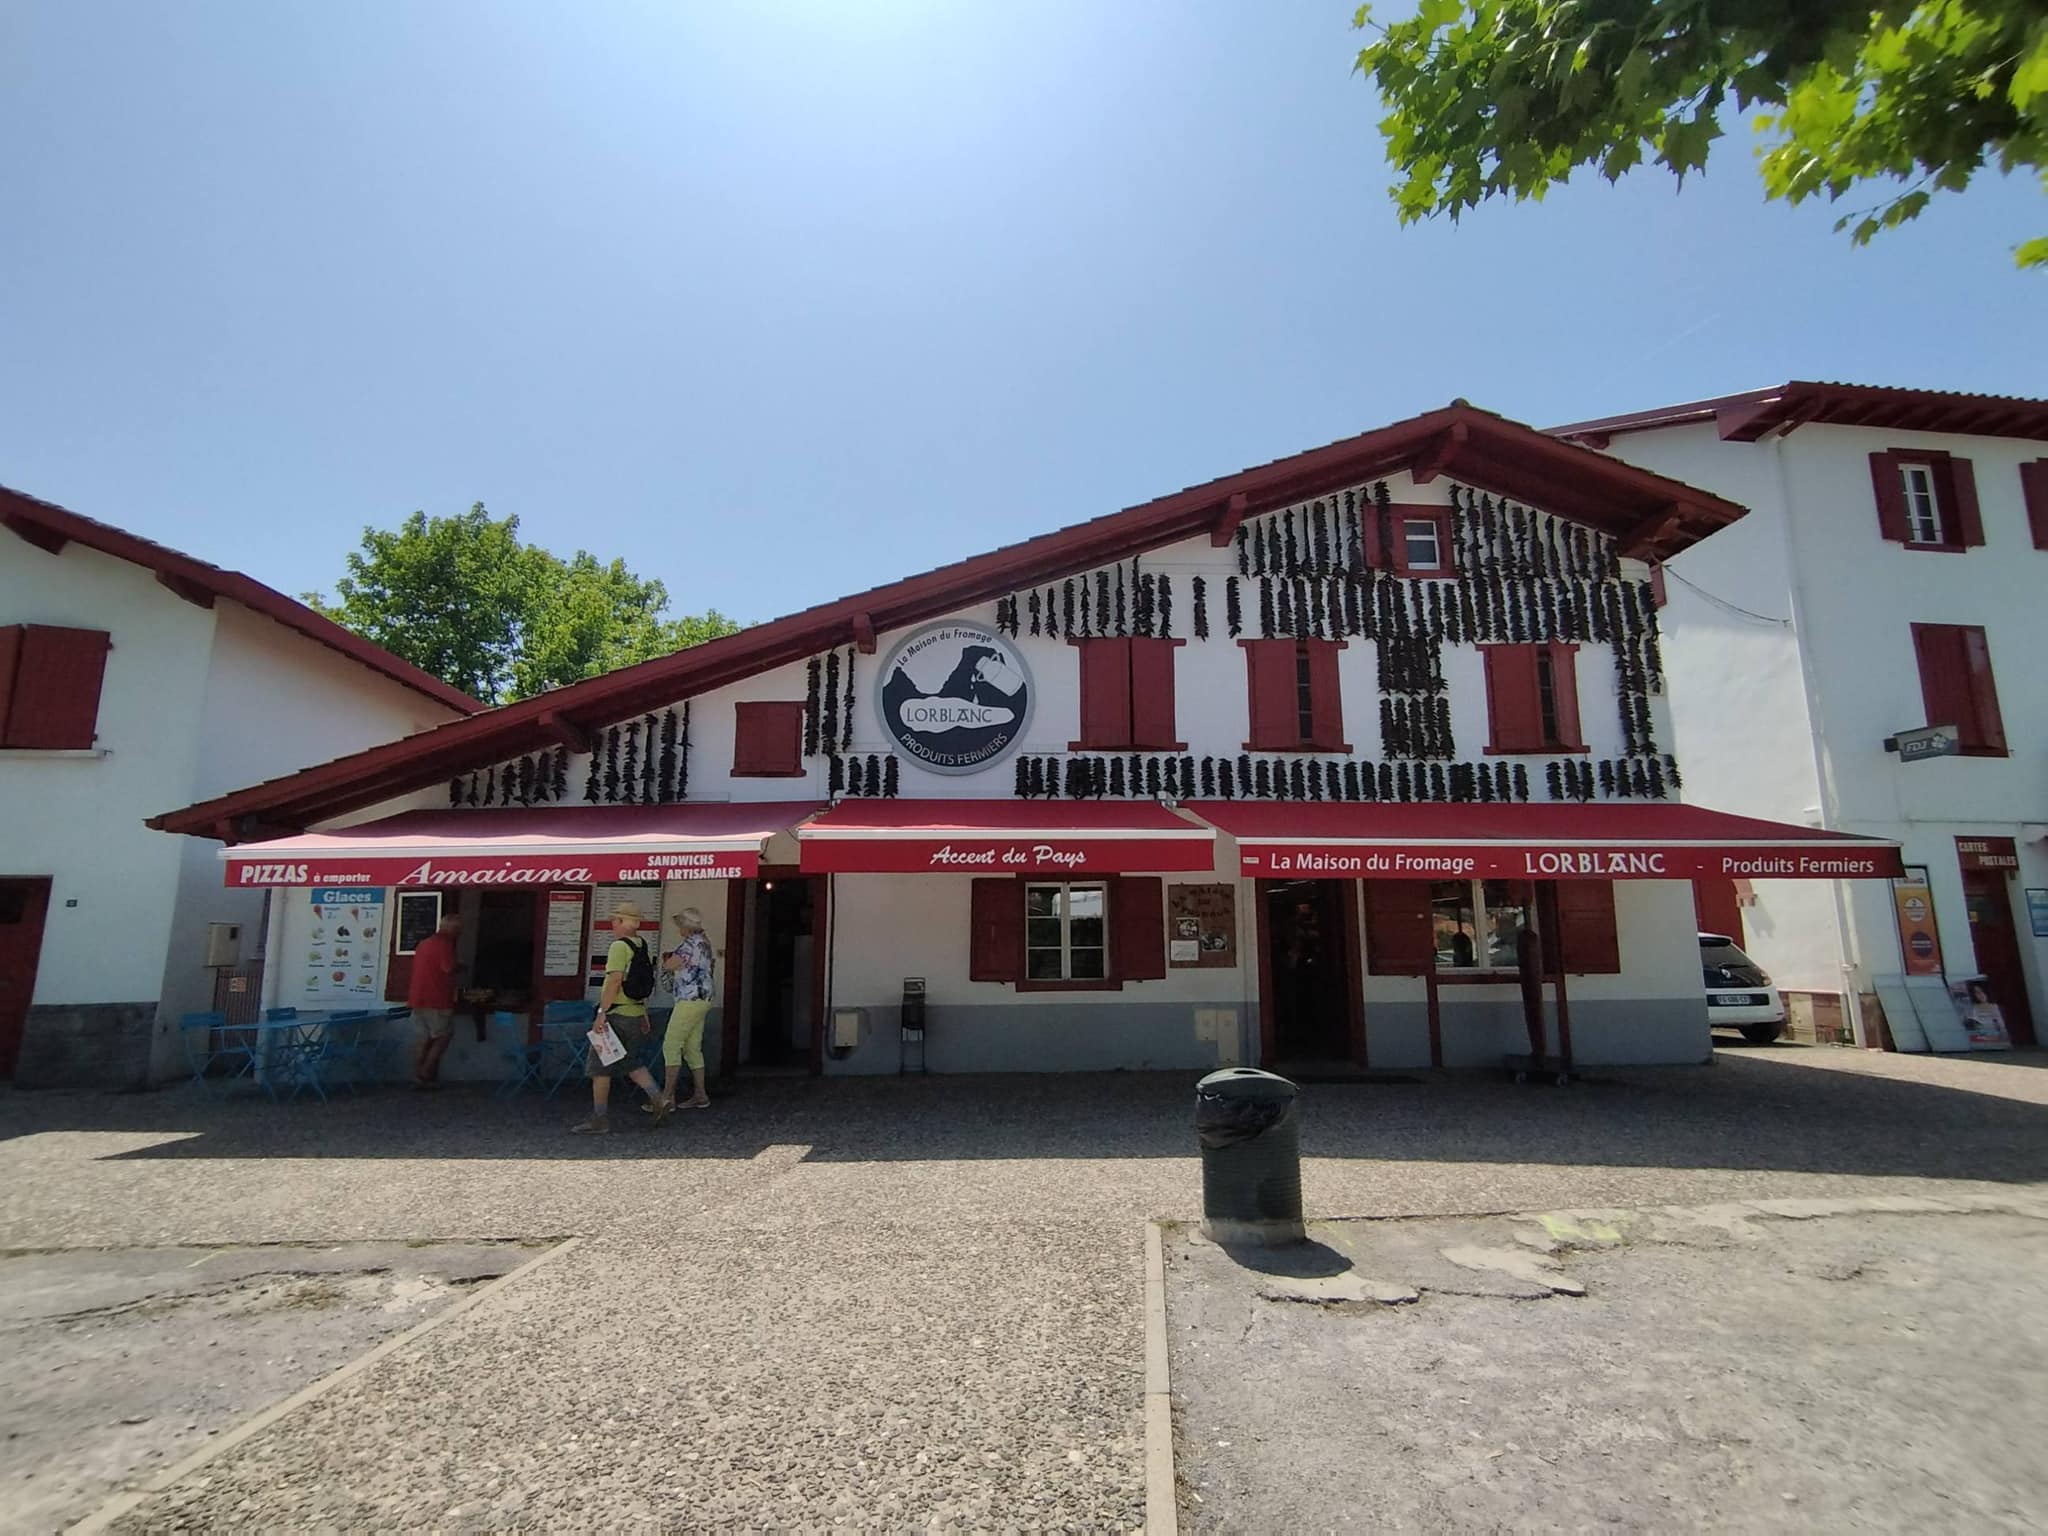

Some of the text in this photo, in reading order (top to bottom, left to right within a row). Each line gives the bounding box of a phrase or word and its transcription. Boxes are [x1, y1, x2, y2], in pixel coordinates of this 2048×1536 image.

[897, 628, 993, 666] La Maison du Fromage
[906, 706, 993, 723] LORBLANC
[901, 733, 1008, 764] PRODUITS FERMIERS
[1906, 739, 1927, 753] FDJ
[647, 854, 715, 867] SANDWICHS
[930, 844, 1087, 869] Accent du Pays
[1270, 853, 1291, 870] La
[1296, 853, 1362, 870] Maison
[1366, 853, 1390, 871] du
[1395, 854, 1475, 874] Fromage
[1524, 852, 1666, 873] LORBLANC
[1721, 856, 1795, 874] Produits
[1799, 857, 1875, 873] Fermiers
[240, 864, 309, 884] PIZZAS
[323, 873, 372, 885] emporter
[397, 860, 592, 884] Amaiana
[618, 867, 742, 881] GLACES ARTISANALES
[323, 890, 372, 903] Glaces
